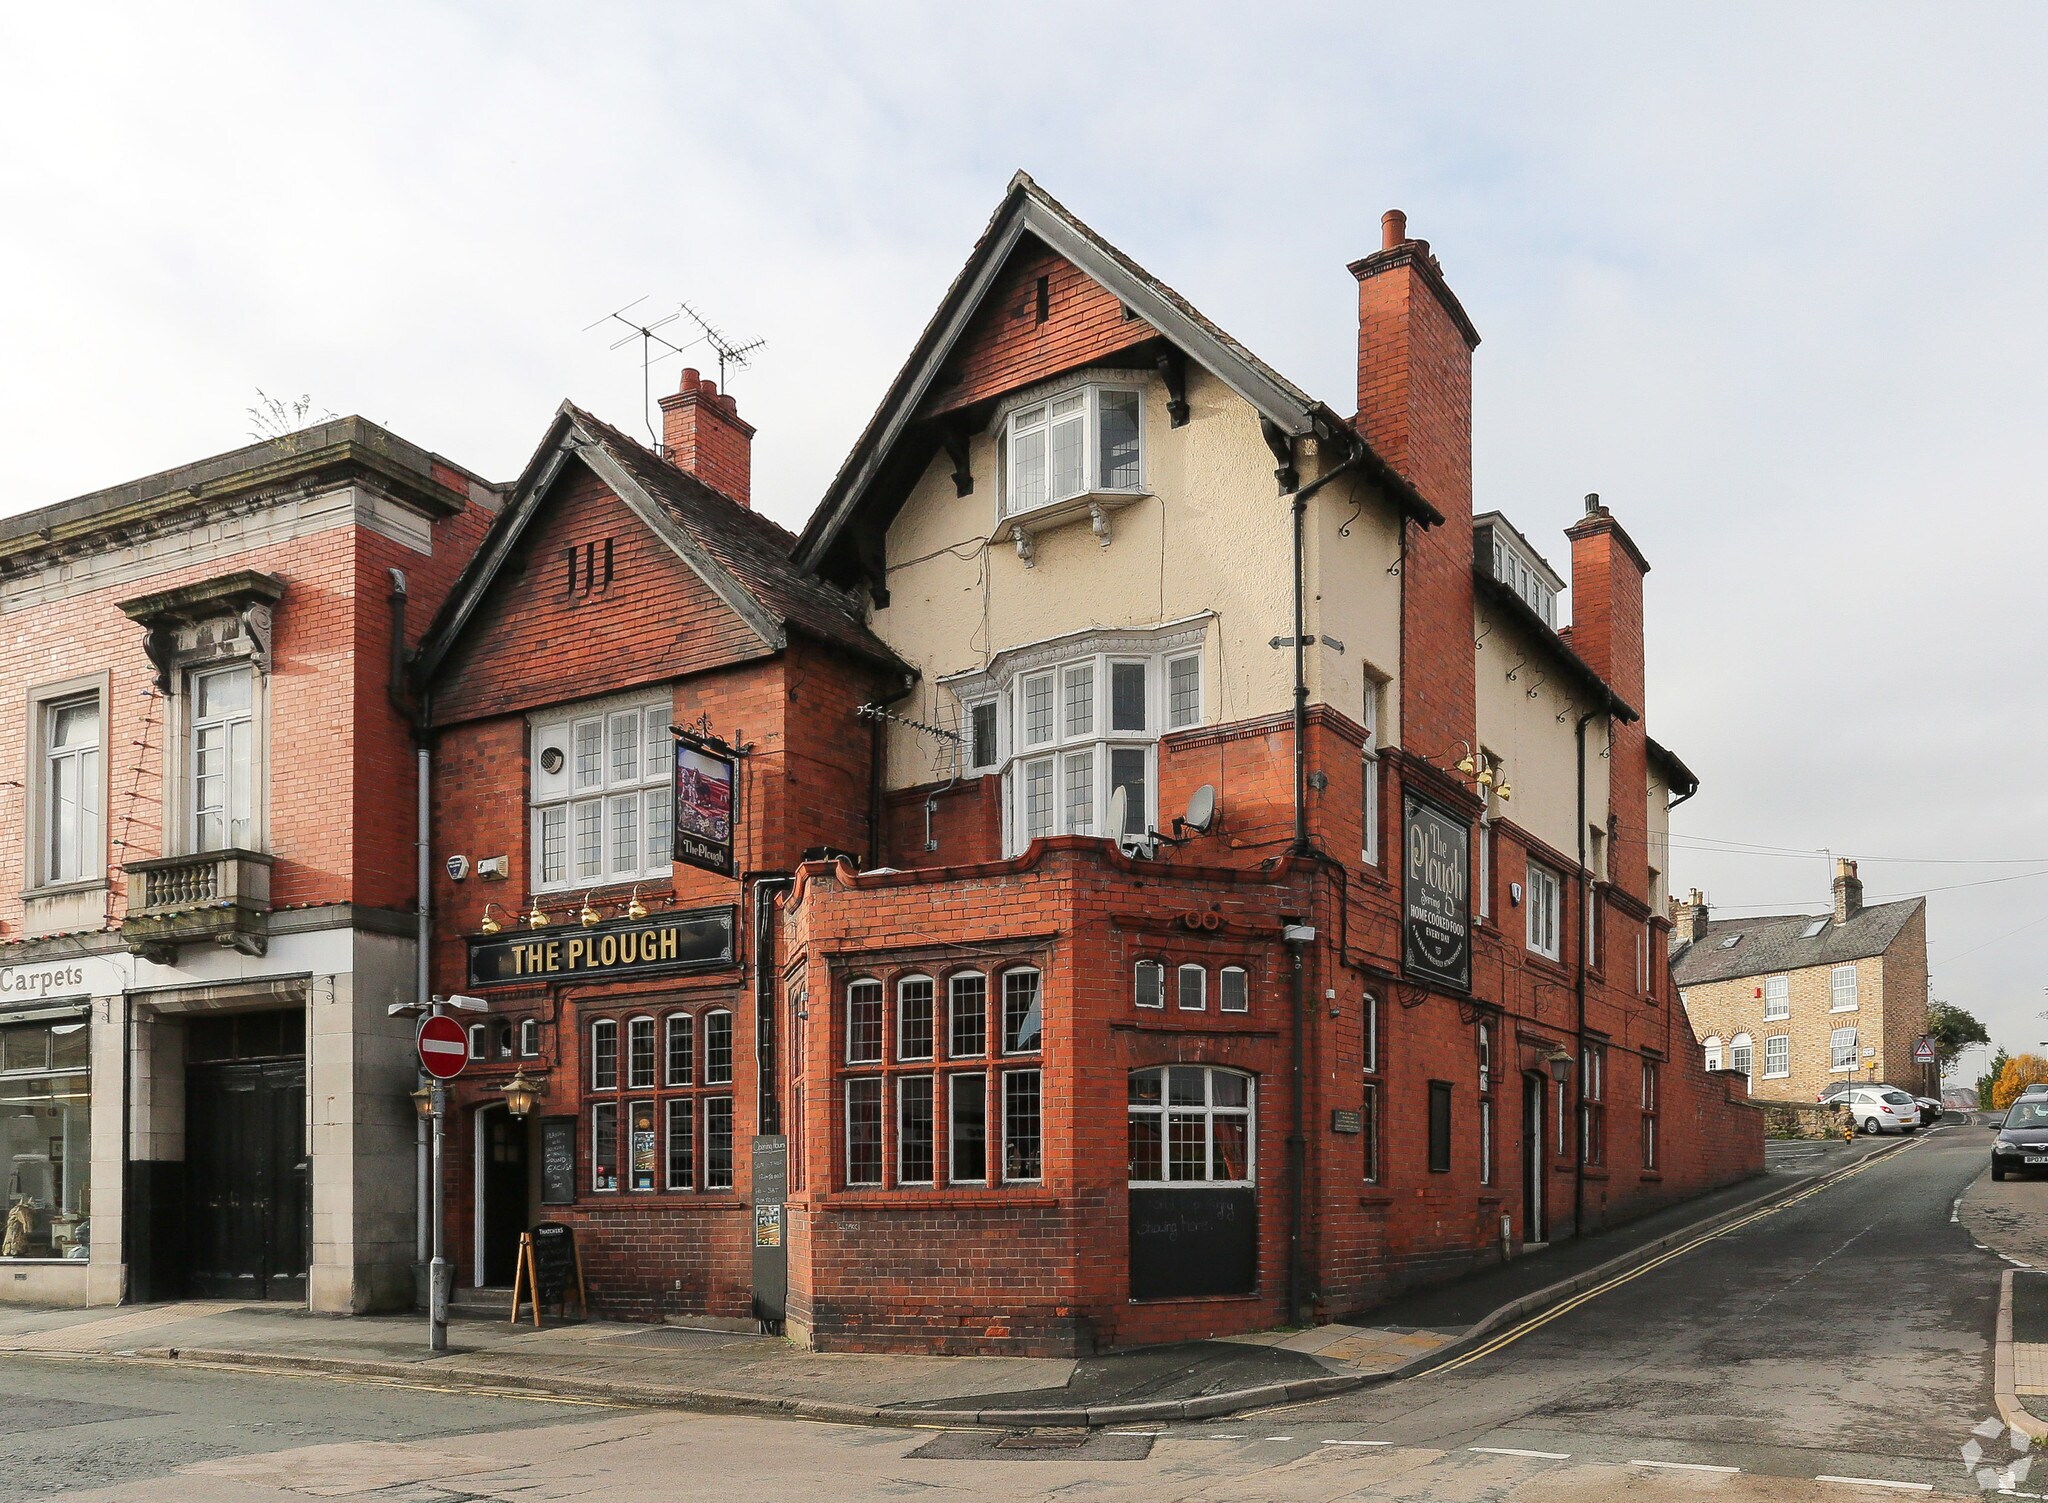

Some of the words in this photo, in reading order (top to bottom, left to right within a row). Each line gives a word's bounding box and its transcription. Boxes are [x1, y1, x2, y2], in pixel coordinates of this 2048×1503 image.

[683, 839, 699, 856] The
[698, 843, 724, 867] Plough
[1429, 822, 1447, 858] The
[1410, 823, 1462, 917] Plough
[1420, 887, 1441, 914] Serving
[1410, 904, 1428, 922] HOME
[1427, 911, 1450, 931] COOKED
[1450, 920, 1465, 937] FOOD
[1425, 926, 1440, 940] EVERY
[1440, 933, 1450, 944] DAY
[511, 941, 560, 975] THE
[568, 928, 678, 969] PLOUGH
[1414, 929, 1425, 952] WARM
[1427, 953, 1444, 968] FRIENDLY
[1443, 941, 1463, 967] ATMOSPHERE
[0, 964, 83, 997] Carpets
[753, 1140, 773, 1155] Opening
[772, 1138, 786, 1149] Hours
